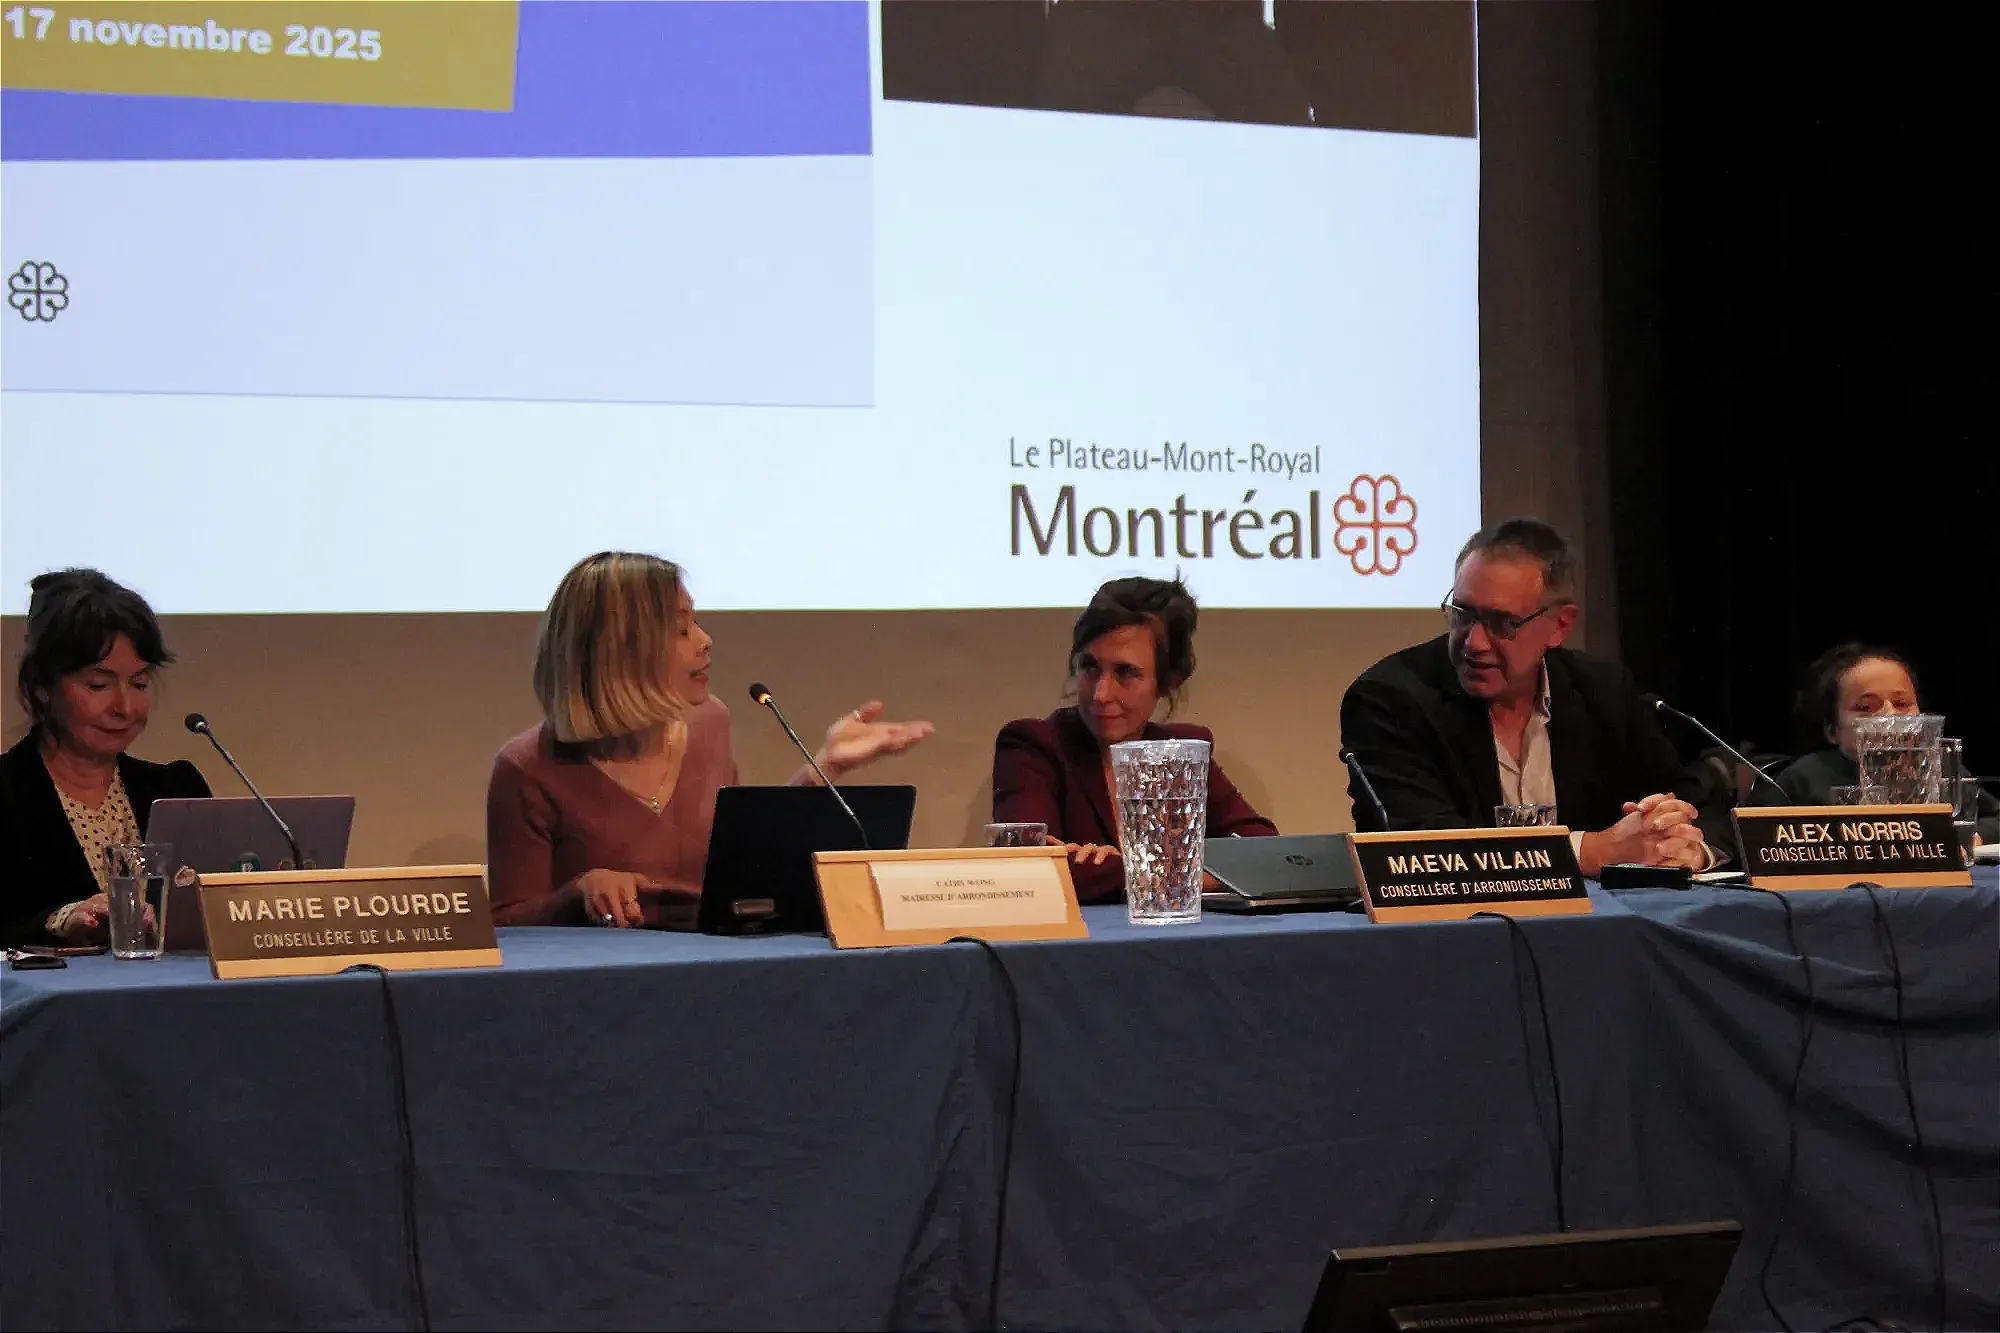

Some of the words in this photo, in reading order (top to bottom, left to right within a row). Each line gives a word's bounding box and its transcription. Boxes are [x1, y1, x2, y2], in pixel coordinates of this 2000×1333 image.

[4, 6, 56, 40] 17
[68, 19, 273, 55] novembre
[283, 24, 383, 61] 2025
[1009, 437, 1040, 469] Le
[1049, 437, 1321, 480] Plateau-Mont-Royal
[1010, 483, 1321, 560] Montréal
[1775, 822, 1834, 844] ALEX
[1840, 820, 1924, 842] NORRIS
[1387, 852, 1469, 875] MAEVA
[1473, 849, 1552, 871] VILAIN
[1760, 844, 1848, 863] CONSEILLER
[1854, 844, 1874, 860] DE
[1880, 844, 1901, 860] LA
[1905, 842, 1948, 859] VILLE
[1380, 880, 1458, 899] CONSEILLÈRE
[1462, 877, 1573, 895] D'ARRONDISSEMENT
[228, 896, 325, 922] MARIE
[332, 892, 472, 918] PLOURDE
[253, 927, 354, 949] CONSEILLÈRE
[360, 928, 380, 945] DE
[385, 927, 406, 944] LA
[411, 926, 453, 943] VILLE
